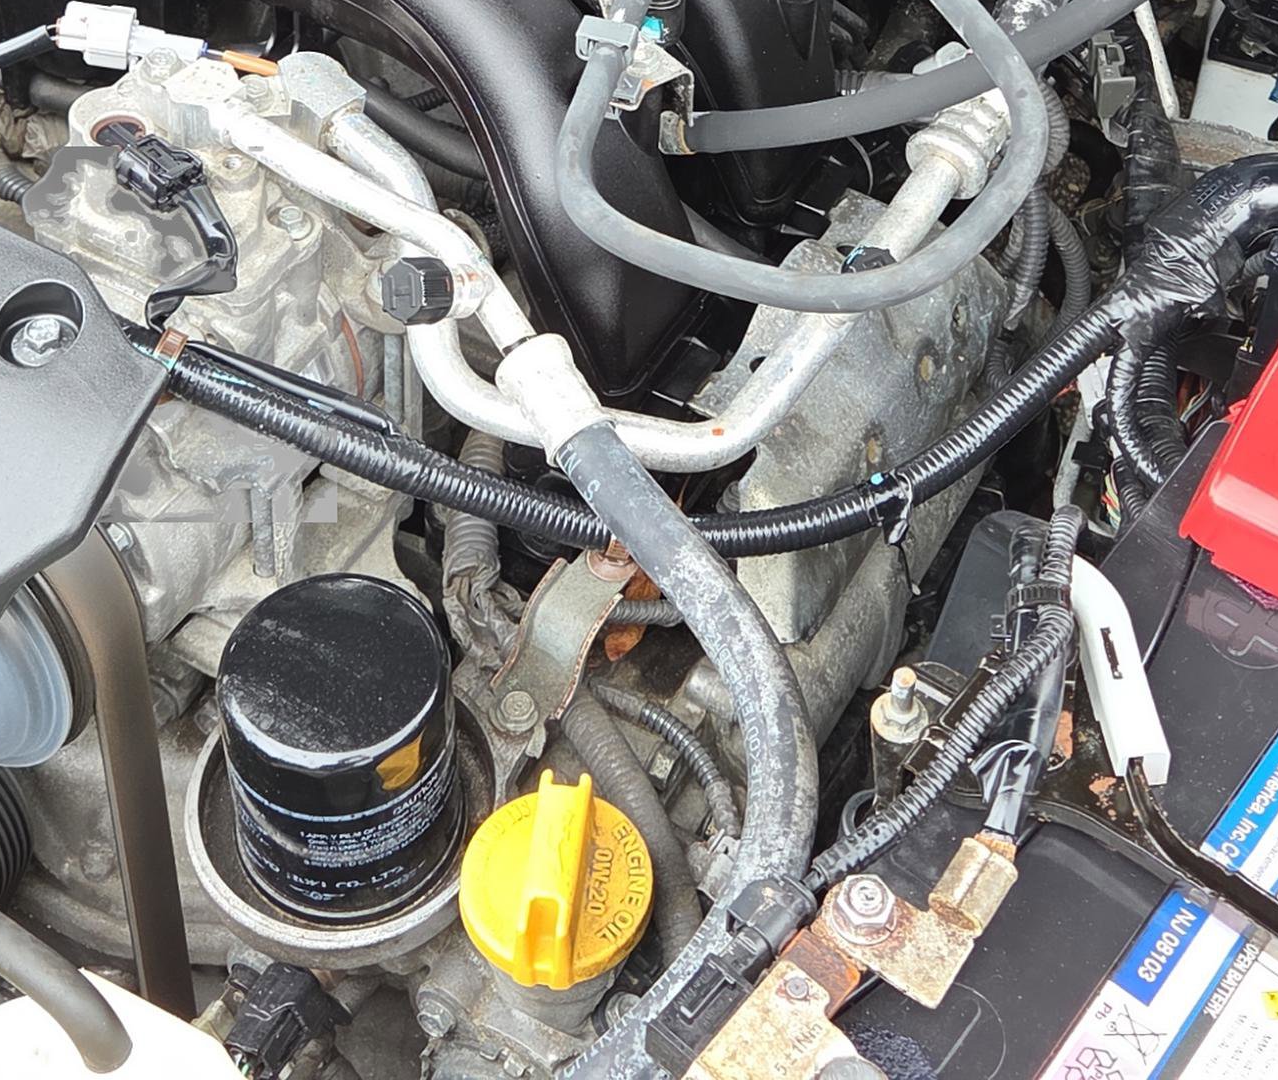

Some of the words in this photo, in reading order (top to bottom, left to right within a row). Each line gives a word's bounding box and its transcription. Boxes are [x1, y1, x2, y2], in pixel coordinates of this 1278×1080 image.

[1229, 817, 1258, 842] Inc.
[586, 847, 613, 916] 0W-20
[611, 820, 647, 909] ENGINE
[594, 909, 635, 946] OIL
[1169, 907, 1196, 936] NJ
[1137, 931, 1180, 983] 08103
[1232, 942, 1261, 974] OPEN
[1094, 1001, 1113, 1020] Pb
[1202, 966, 1244, 1021] BATTERY.
